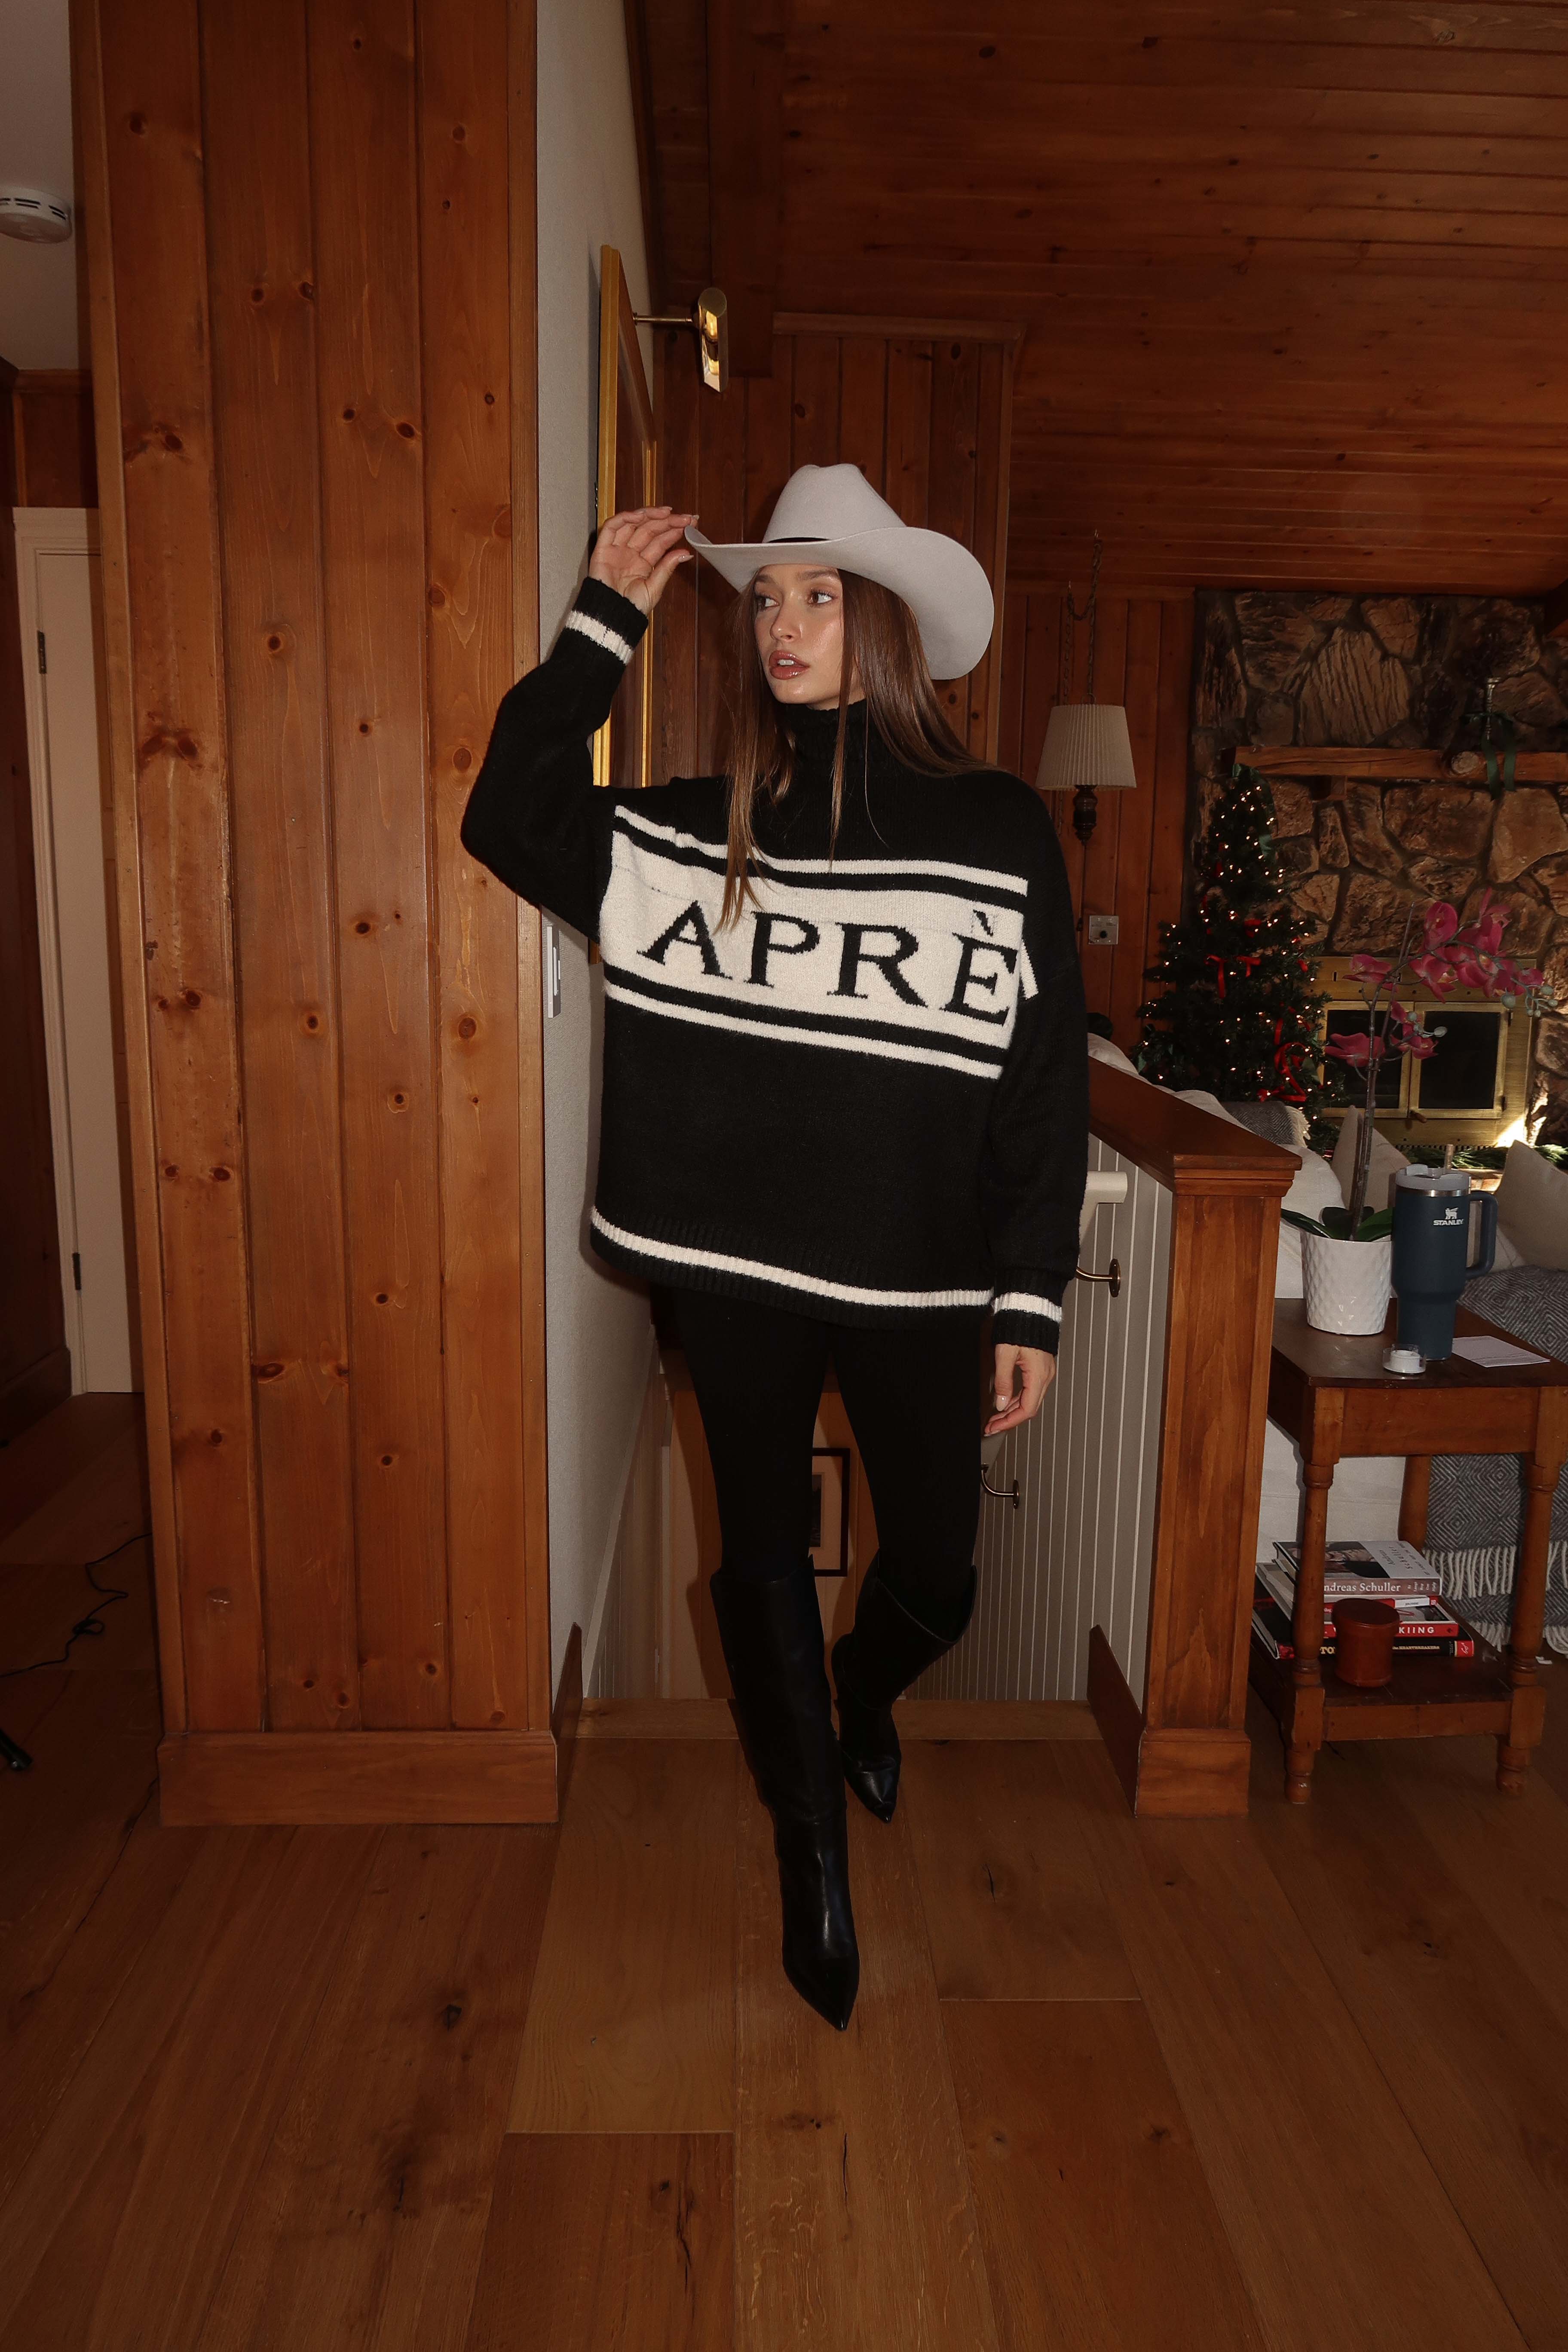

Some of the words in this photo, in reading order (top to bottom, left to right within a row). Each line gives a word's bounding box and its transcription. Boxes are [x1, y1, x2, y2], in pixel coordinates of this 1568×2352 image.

[1323, 1582, 1357, 1592] ndreas
[1360, 1582, 1402, 1592] Schuller
[1320, 1646, 1335, 1654] TO
